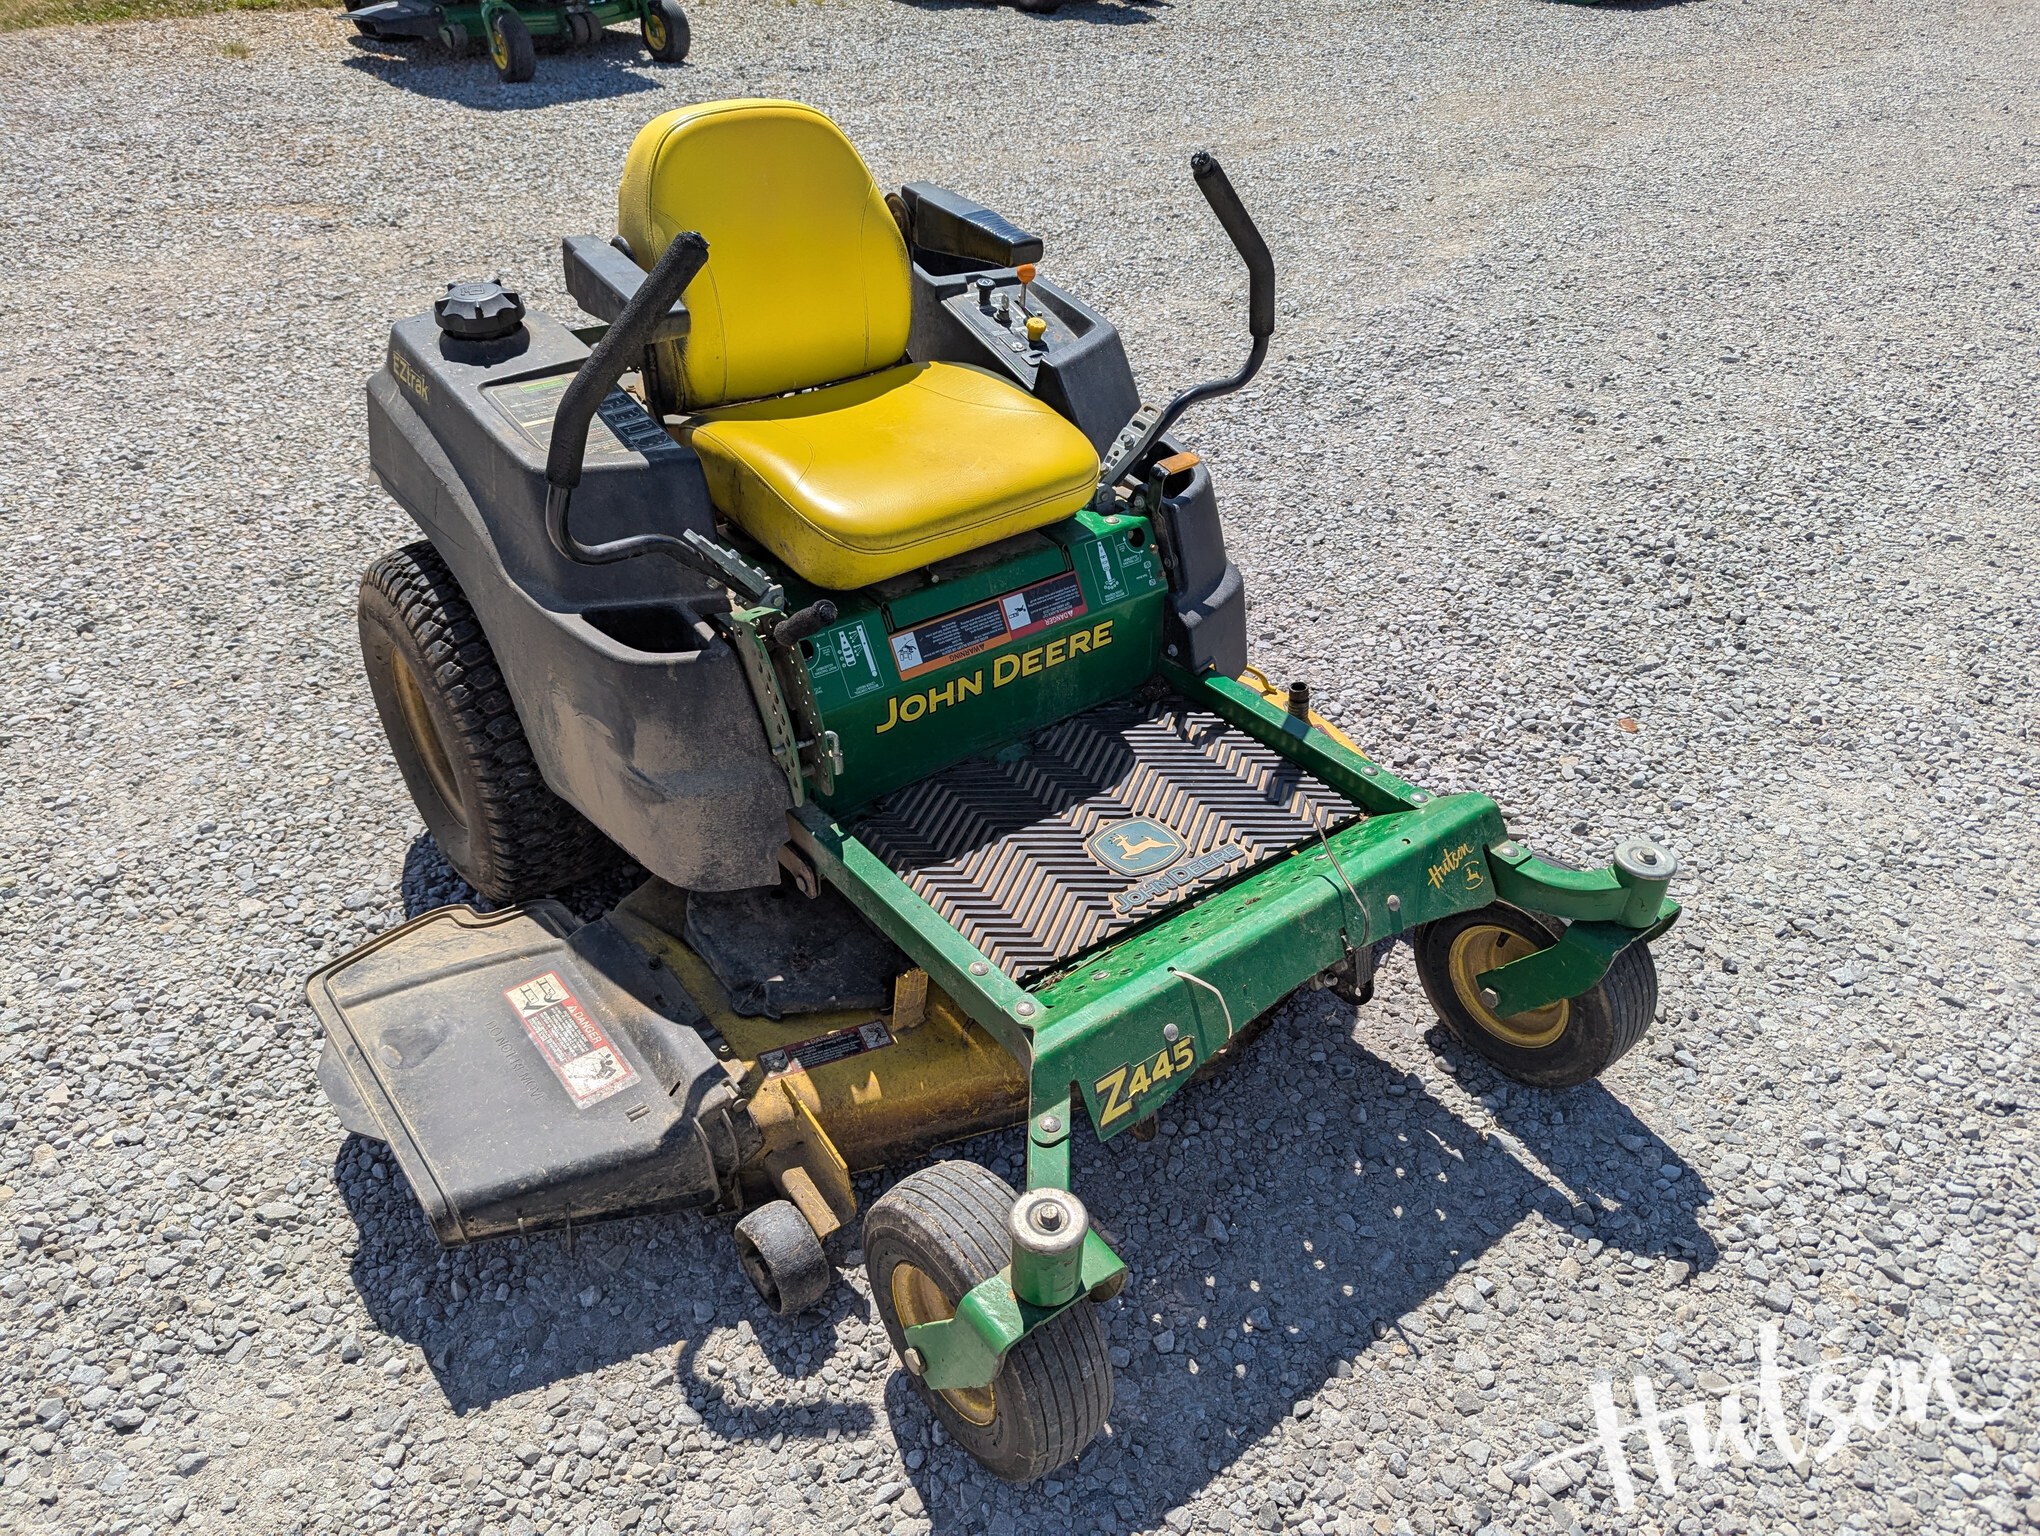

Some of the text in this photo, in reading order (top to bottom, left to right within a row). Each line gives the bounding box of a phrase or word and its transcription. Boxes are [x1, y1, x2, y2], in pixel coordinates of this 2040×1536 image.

[393, 353, 430, 402] EZtrak
[1044, 612, 1068, 625] DANGER
[875, 668, 985, 735] JOHN
[992, 619, 1115, 690] DEERE
[949, 645, 980, 661] WARNING
[1115, 843, 1246, 914] JOHN DEERE
[1427, 843, 1475, 890] Hutson
[574, 1012, 602, 1044] DANGER
[811, 1032, 841, 1045] DANGER
[486, 1020, 545, 1105] DO NOT REMOVE
[1095, 1036, 1197, 1129] Z445
